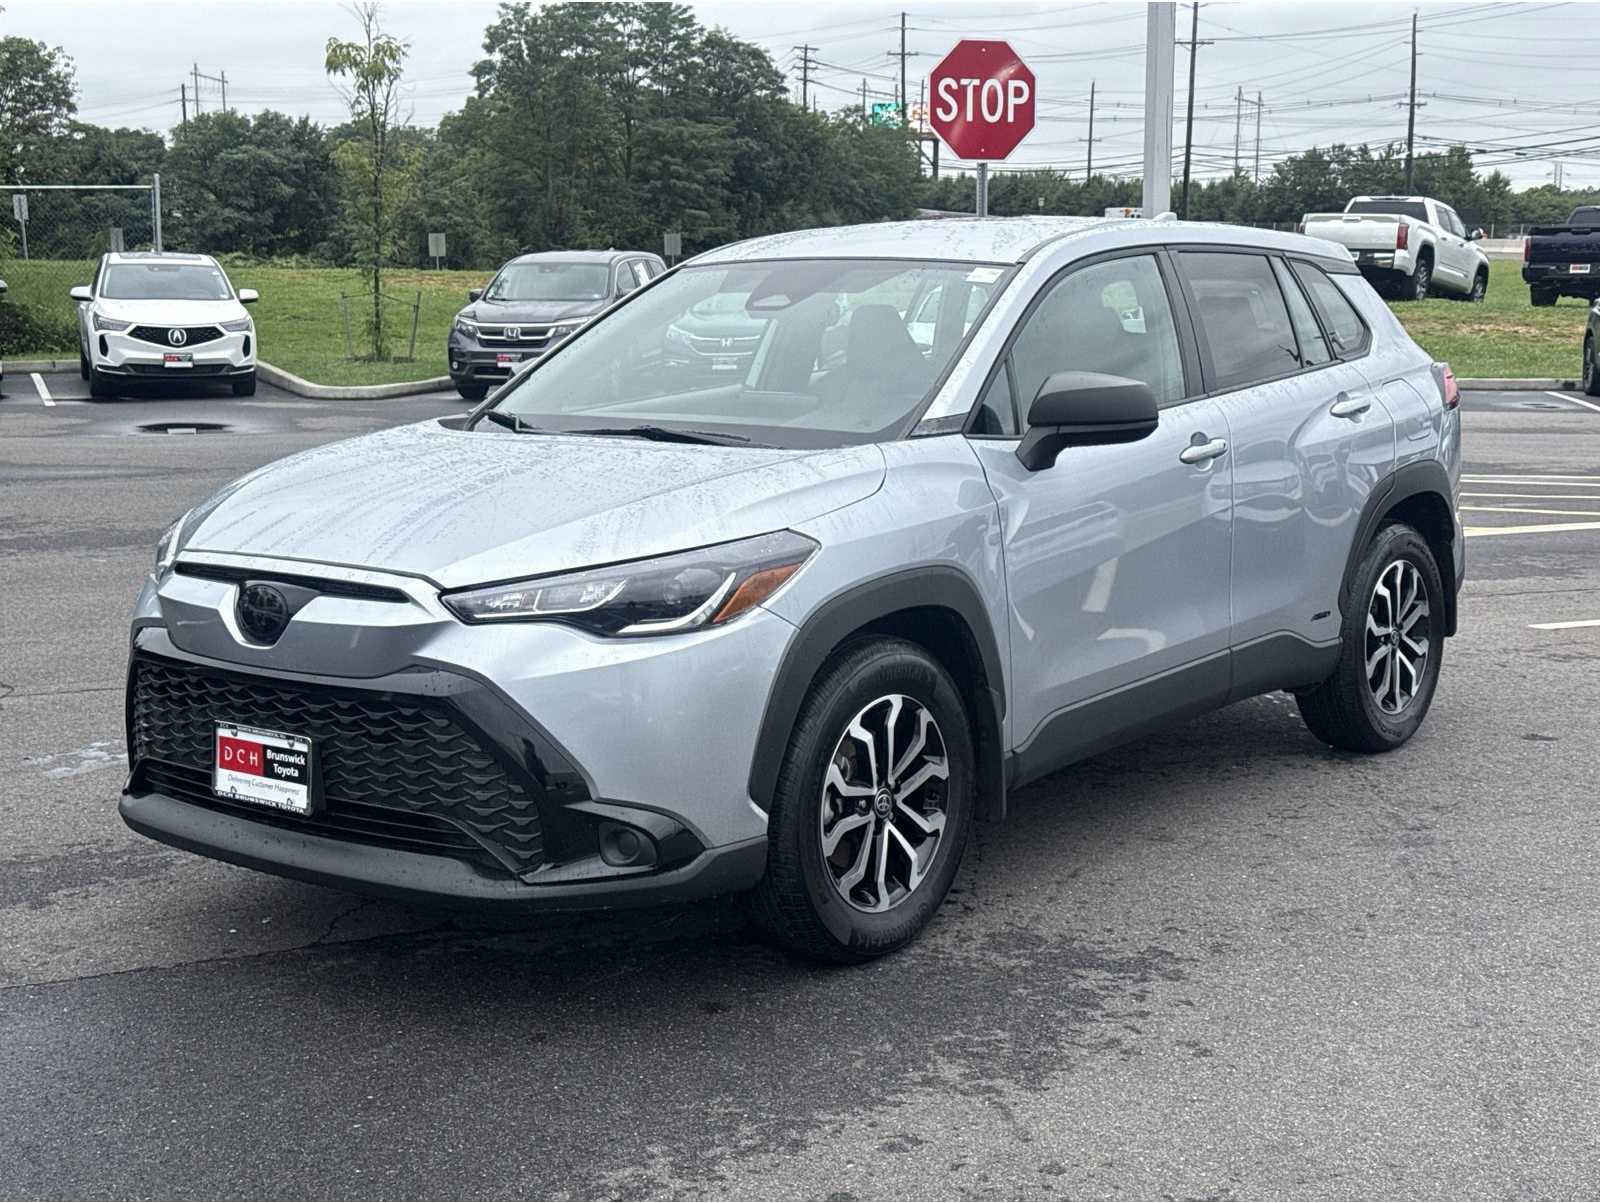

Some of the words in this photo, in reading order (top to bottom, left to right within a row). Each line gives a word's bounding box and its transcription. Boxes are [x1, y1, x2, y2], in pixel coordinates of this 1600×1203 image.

[936, 77, 1030, 124] STOP
[224, 746, 258, 767] DCH
[266, 749, 306, 767] Brunswick
[273, 763, 299, 778] Toyota
